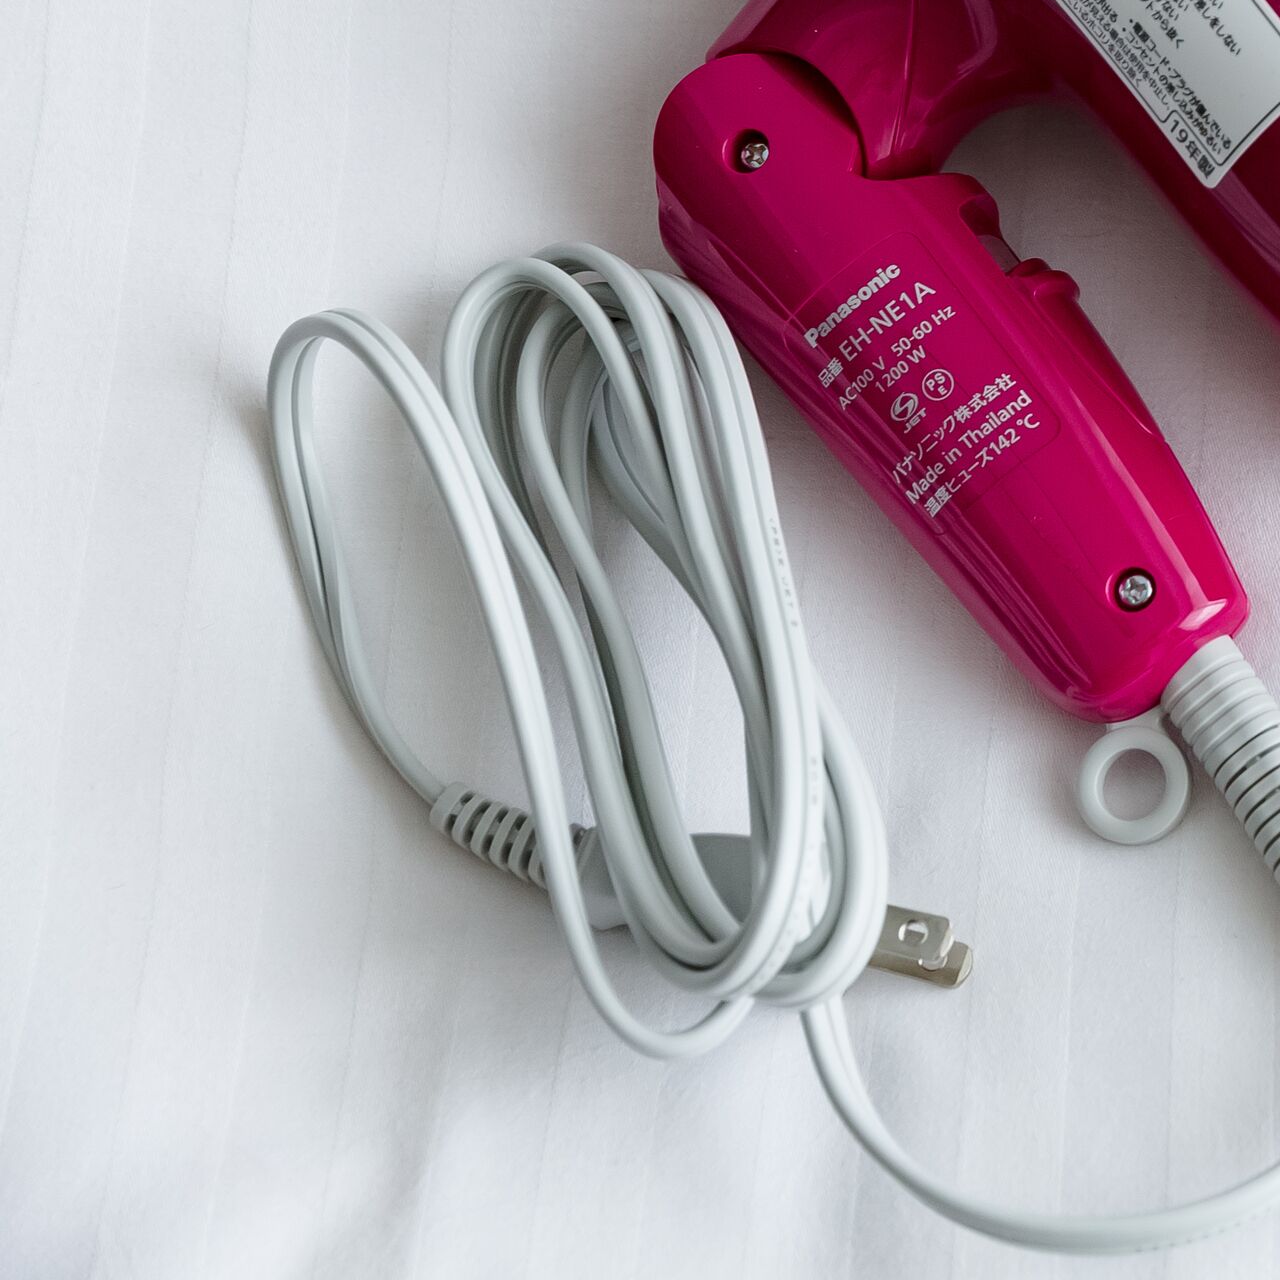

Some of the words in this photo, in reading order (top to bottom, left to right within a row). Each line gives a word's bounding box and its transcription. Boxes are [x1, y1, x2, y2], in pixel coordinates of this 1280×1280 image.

[1164, 117, 1218, 179] 19年製
[803, 263, 902, 349] Panasonic
[818, 357, 844, 389] 品番
[839, 282, 937, 361] EH-NE1A
[838, 369, 875, 411] AC100
[872, 356, 888, 373] V
[891, 320, 933, 357] 50-60
[933, 303, 956, 325] Hz
[907, 345, 928, 364] W
[892, 373, 1017, 484] パナソニック株式会社
[905, 464, 946, 504] Made
[942, 444, 963, 465] in
[959, 390, 1033, 448] Thailand
